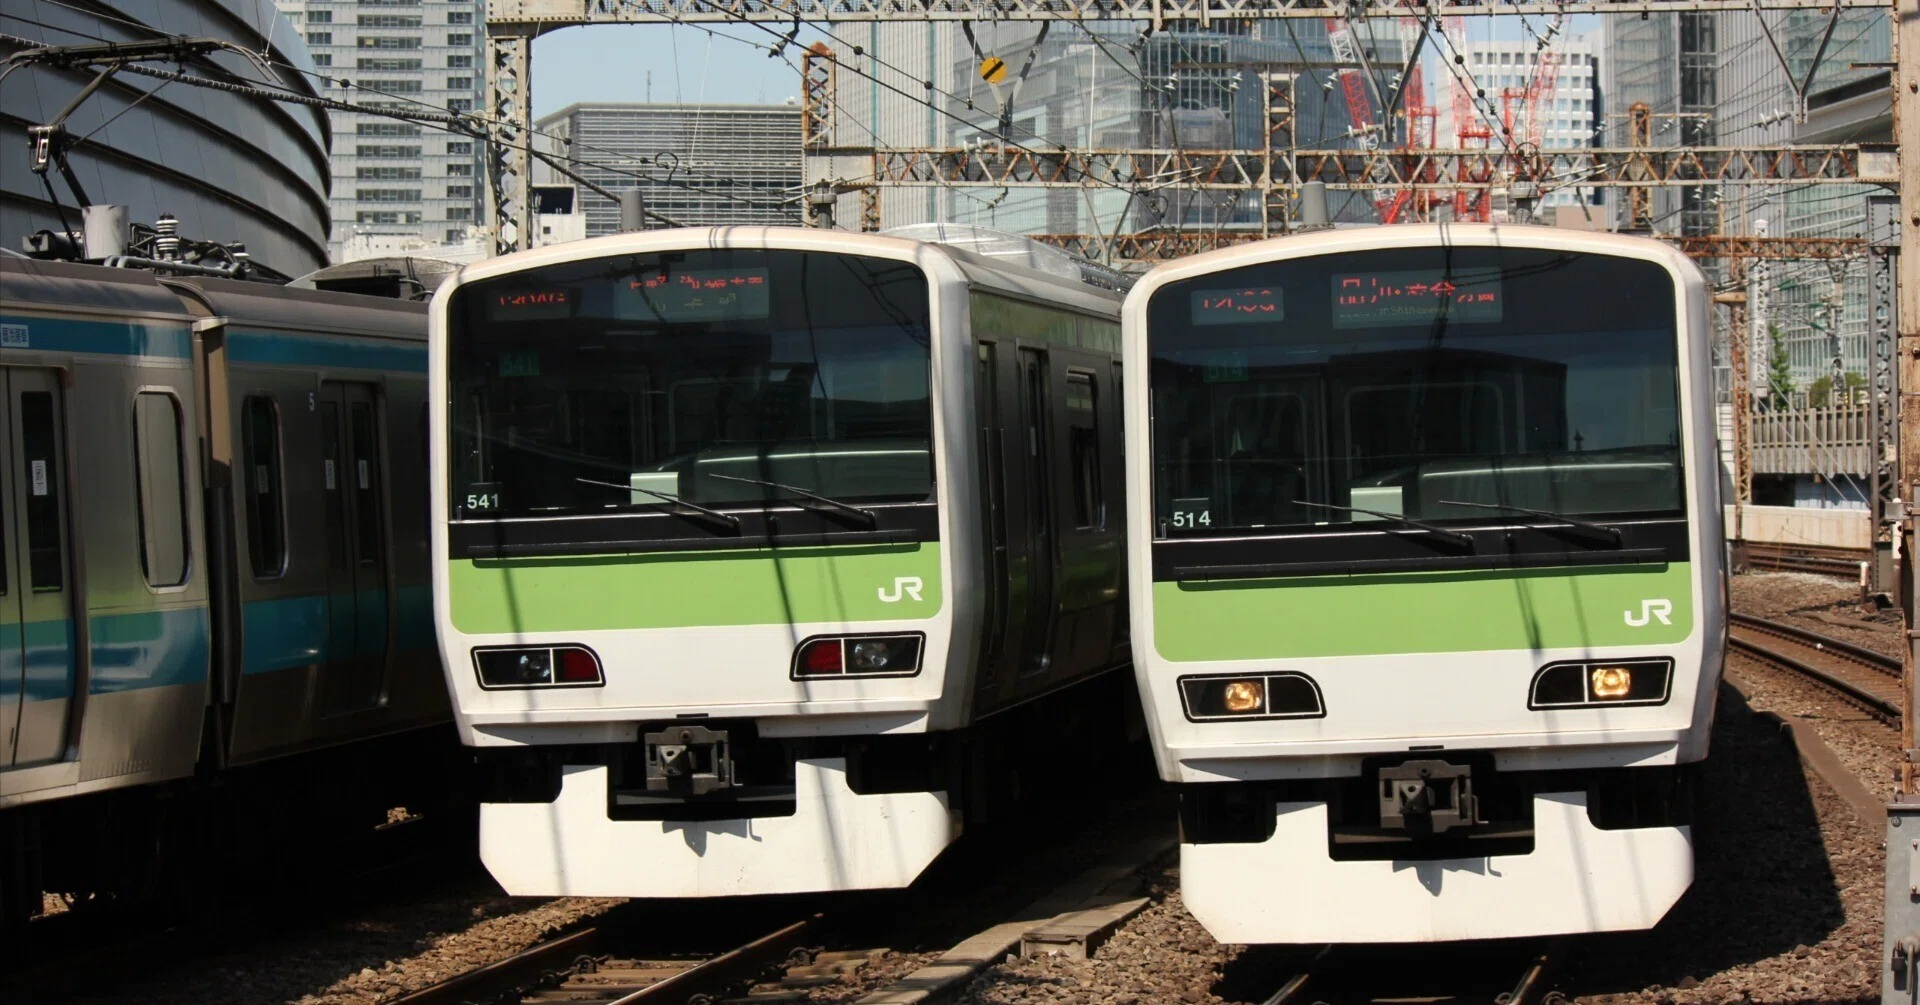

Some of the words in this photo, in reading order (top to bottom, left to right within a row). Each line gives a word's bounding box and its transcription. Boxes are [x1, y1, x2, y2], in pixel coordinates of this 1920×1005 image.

[308, 392, 315, 411] 5
[467, 493, 499, 510] 541
[1173, 510, 1212, 528] 514
[877, 576, 924, 603] JR
[1624, 598, 1673, 627] JR
